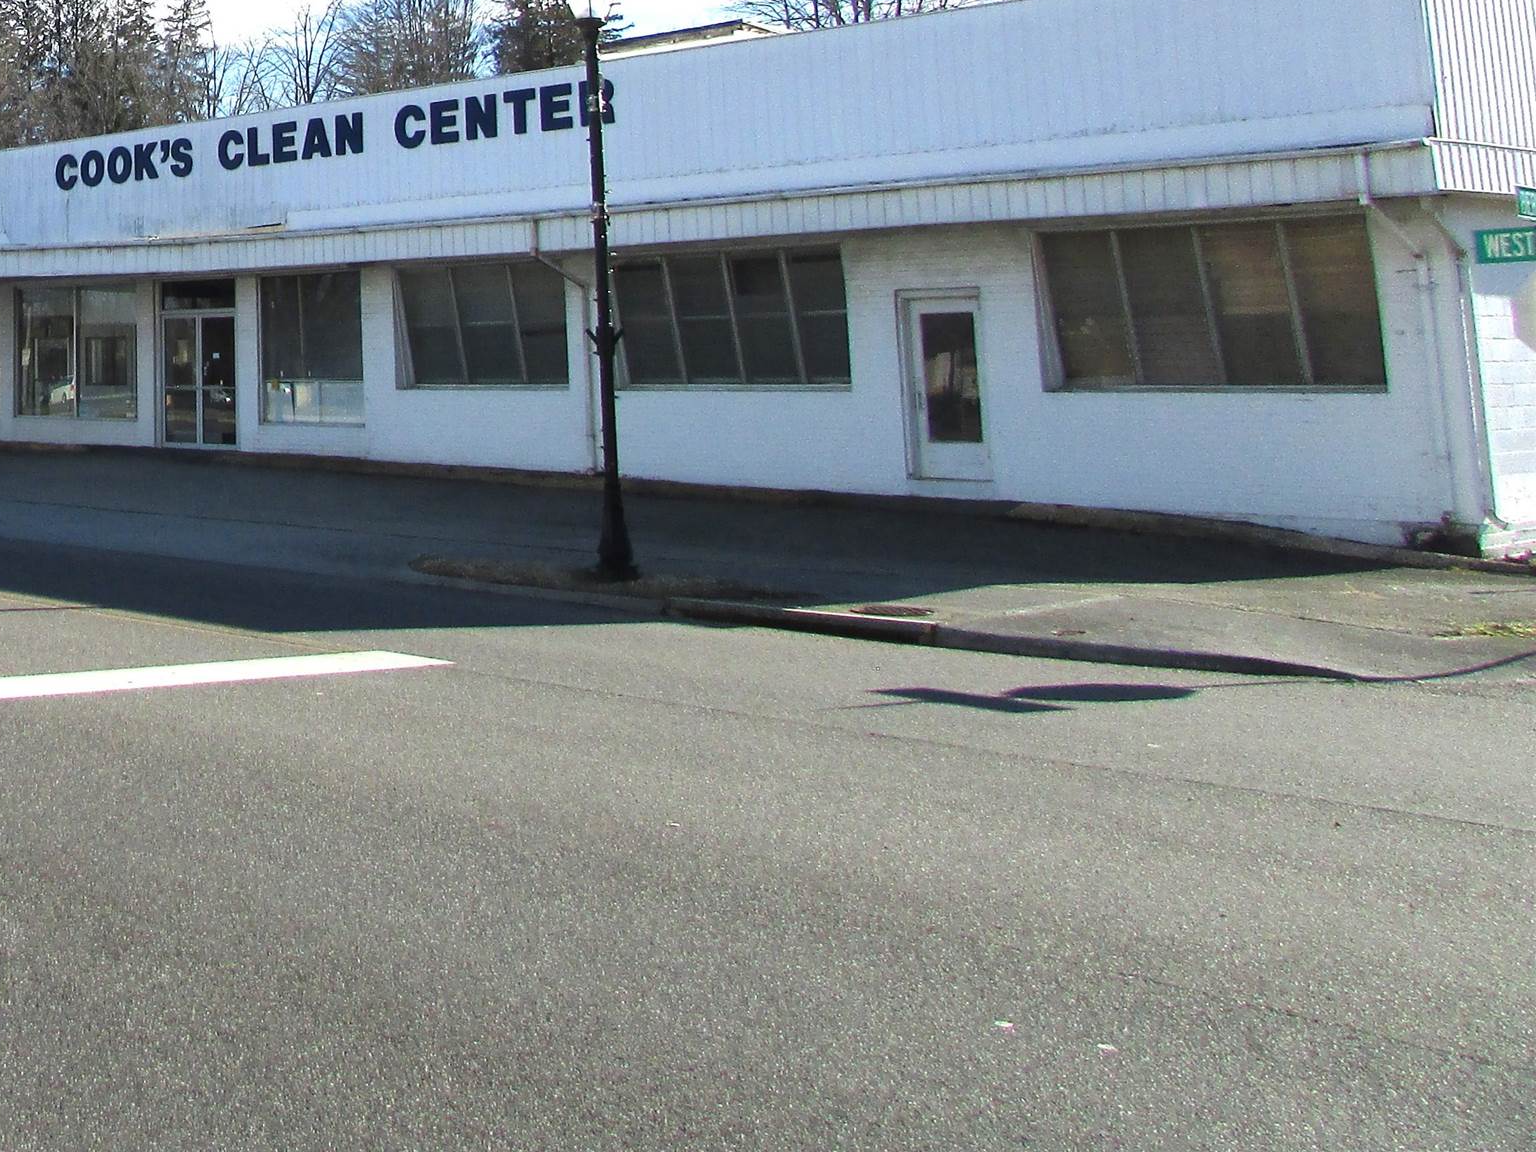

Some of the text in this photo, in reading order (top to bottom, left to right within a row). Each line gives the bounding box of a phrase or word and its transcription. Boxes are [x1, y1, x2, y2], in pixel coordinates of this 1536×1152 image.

[55, 79, 615, 190] COOK'S CLEAN CENTER
[1483, 232, 1535, 258] WEST
